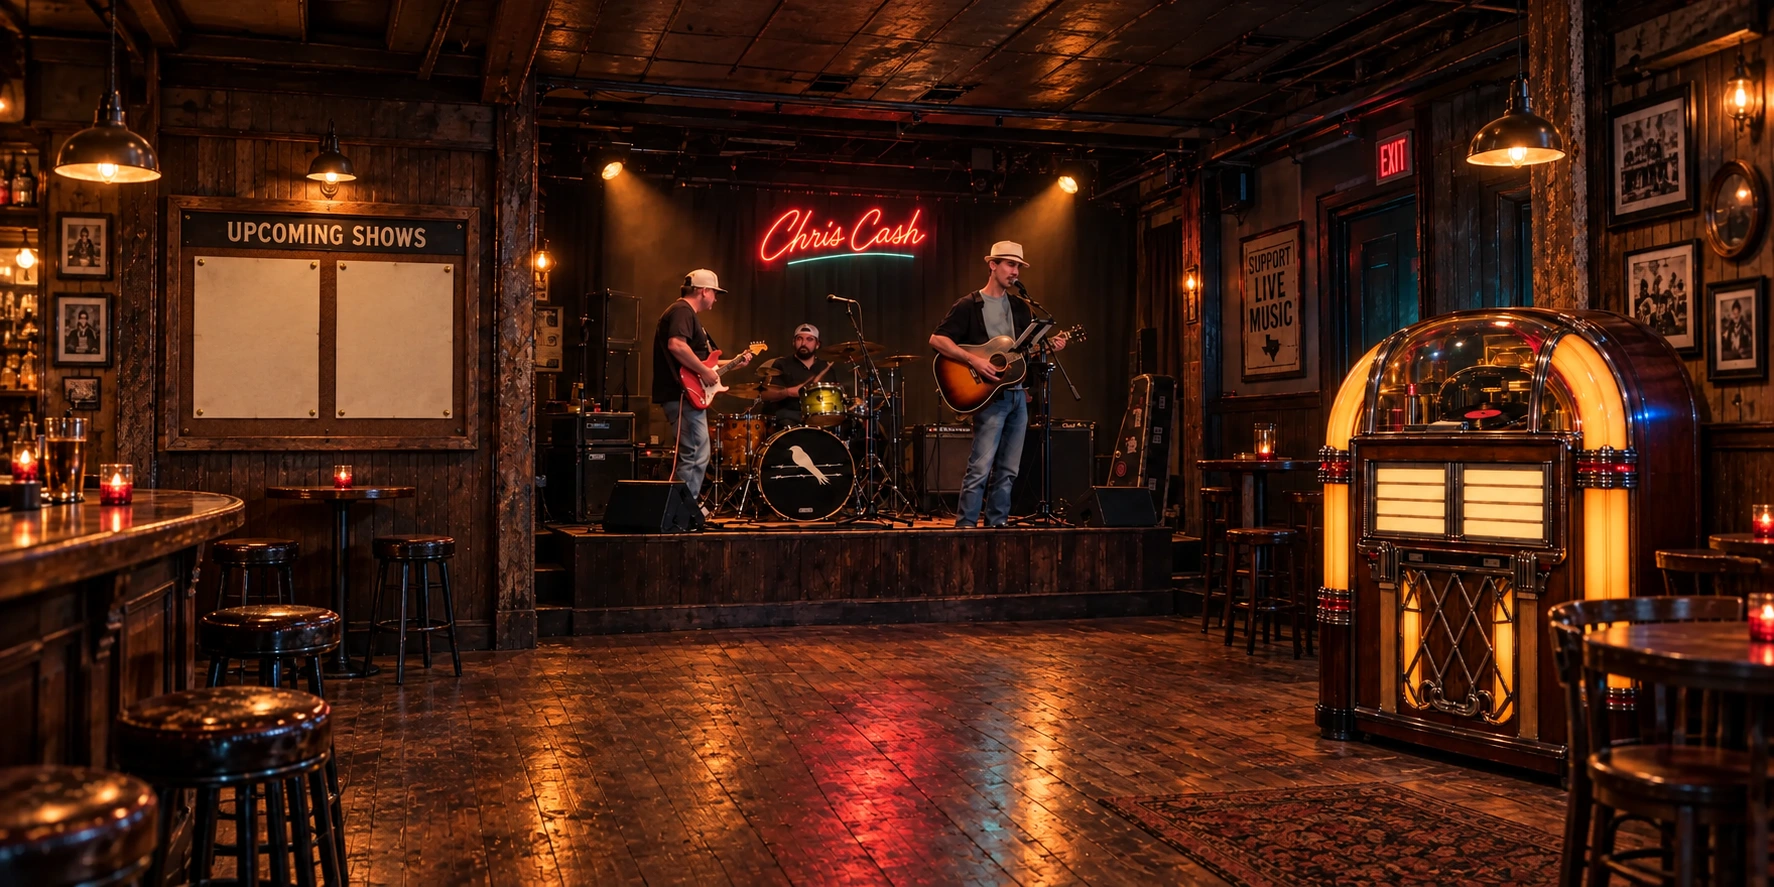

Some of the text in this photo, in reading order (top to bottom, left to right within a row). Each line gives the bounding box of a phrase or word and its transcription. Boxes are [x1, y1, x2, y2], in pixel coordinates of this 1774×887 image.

[1380, 138, 1406, 177] EXIT
[227, 221, 427, 248] UPCOMING SHOWS
[760, 208, 925, 261] Chris Cash
[1248, 246, 1291, 275] SUPPORT
[1255, 271, 1286, 303] LIVE
[1249, 300, 1293, 333] MUSIC
